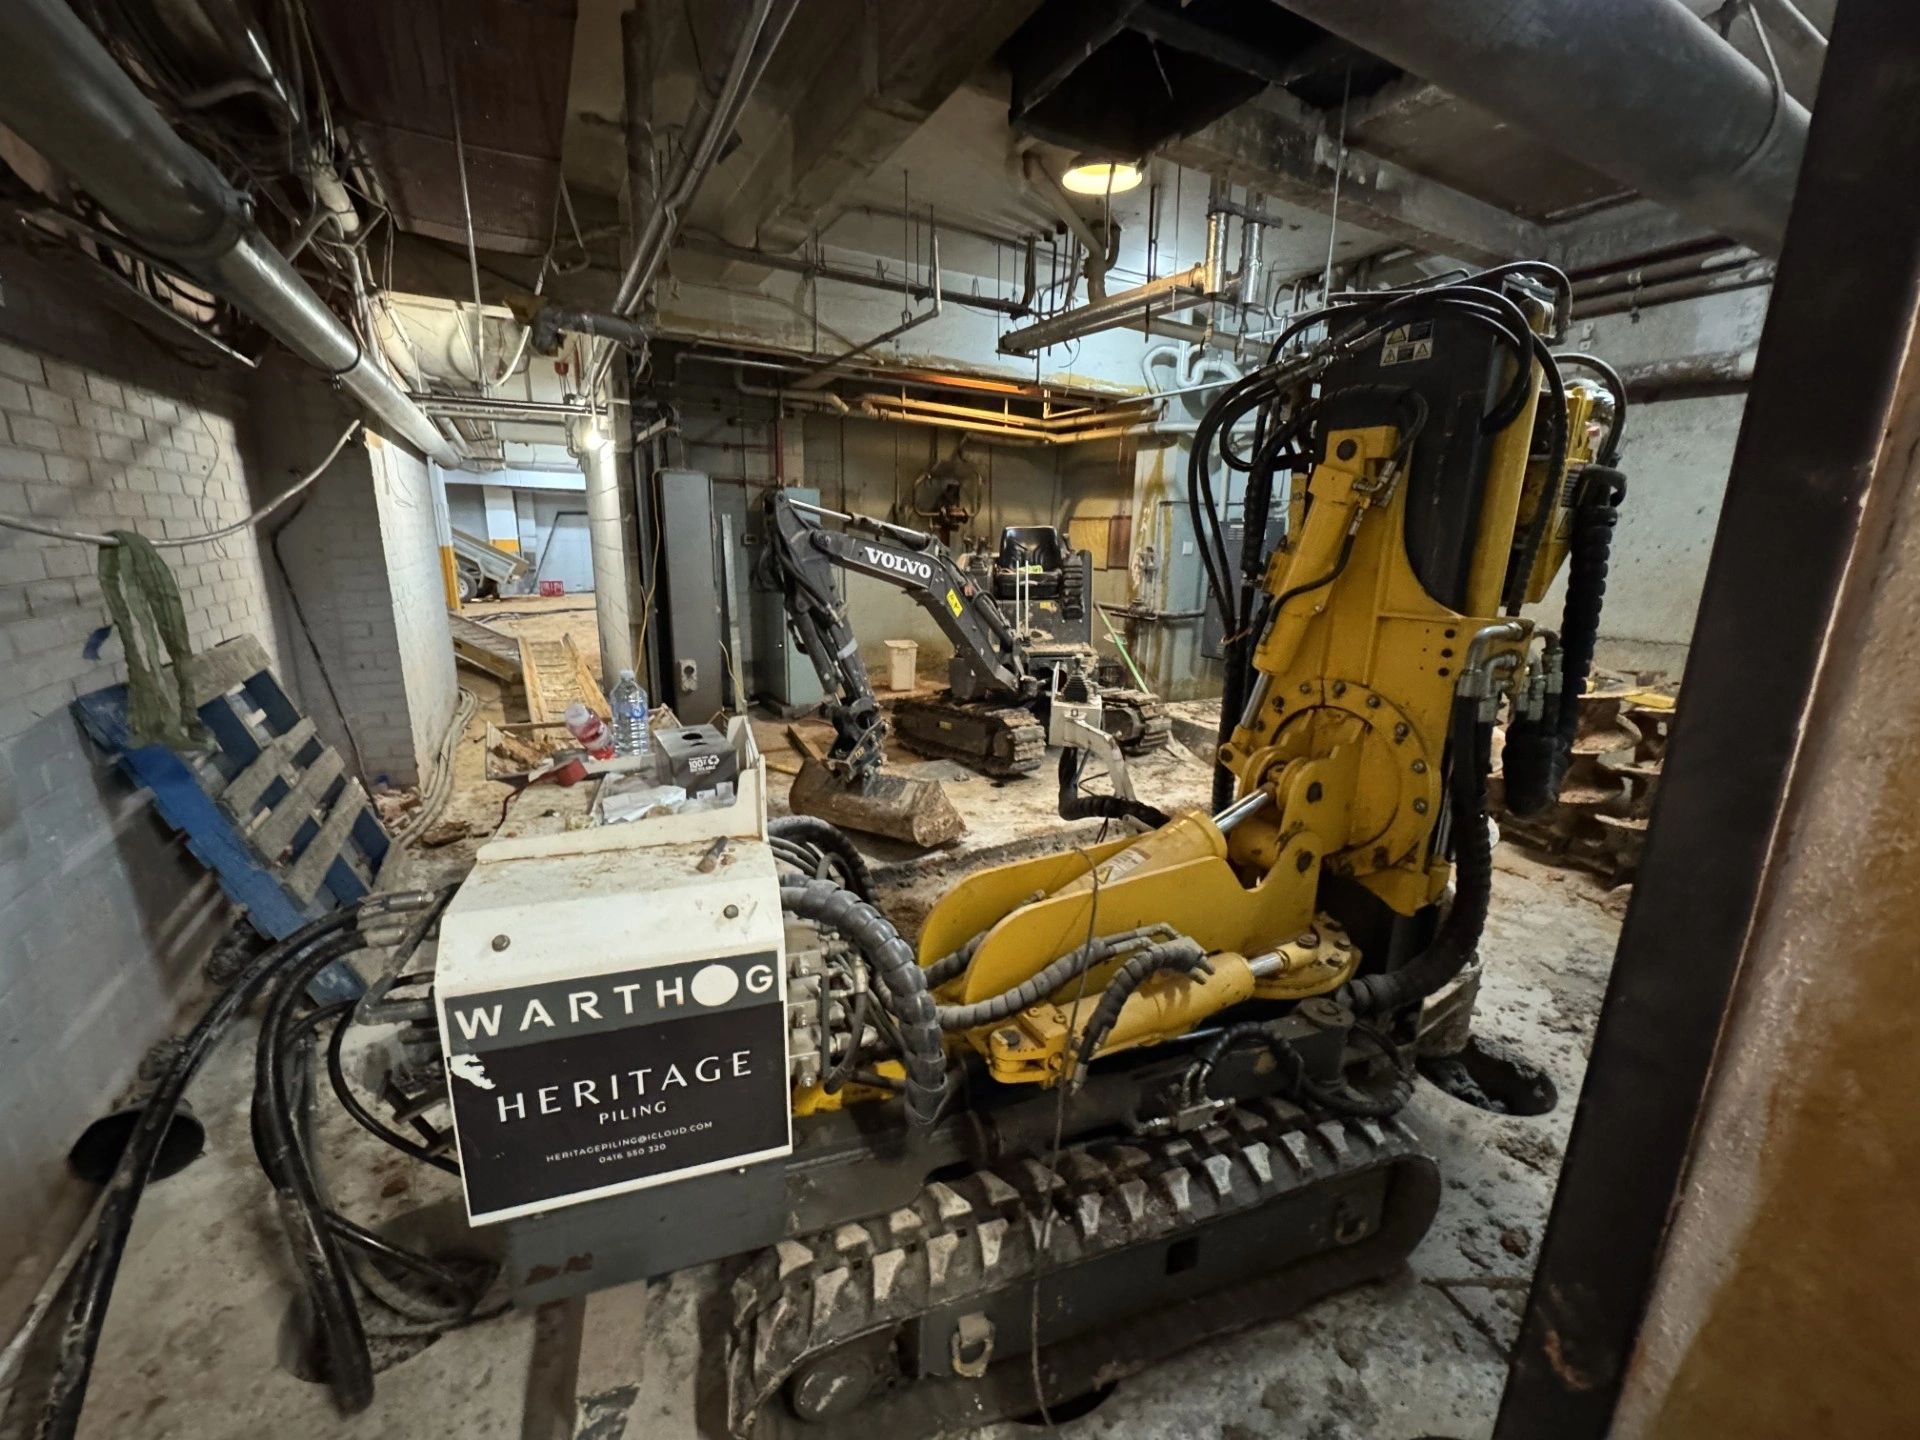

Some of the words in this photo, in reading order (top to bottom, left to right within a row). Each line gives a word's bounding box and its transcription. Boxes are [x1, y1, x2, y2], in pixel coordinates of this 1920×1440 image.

[864, 546, 932, 579] VOLVO
[454, 964, 774, 1040] WARTHOG
[497, 1050, 752, 1122] HERITAGE
[599, 1100, 668, 1125] PILING
[546, 1121, 713, 1162] HERITAGEPILING@ICLOUD.COM
[598, 1152, 623, 1164] 0416
[648, 1143, 667, 1154] 320
